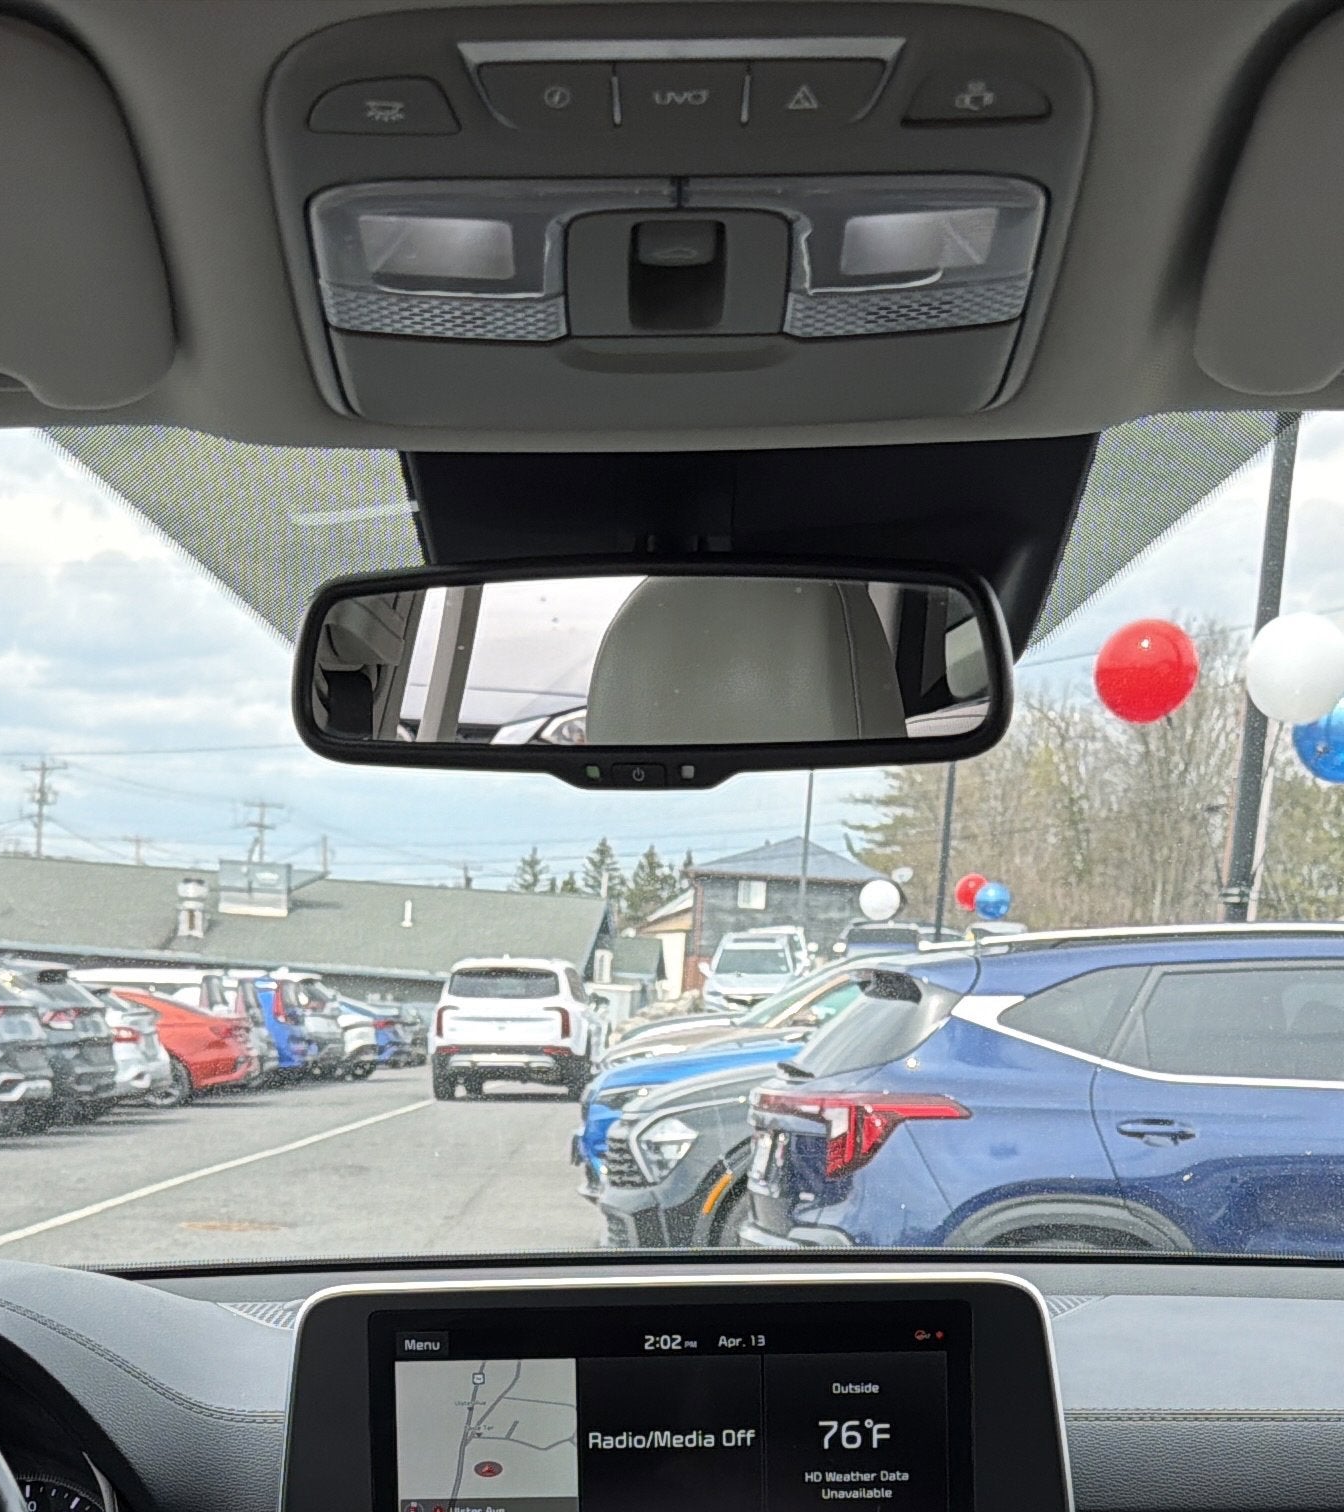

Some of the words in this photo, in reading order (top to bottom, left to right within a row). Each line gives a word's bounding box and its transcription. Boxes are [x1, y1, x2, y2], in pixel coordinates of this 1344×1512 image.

[404, 1339, 441, 1351] Menu
[644, 1335, 682, 1350] 2:02
[684, 1340, 698, 1349] PM
[718, 1335, 746, 1349] Apr.
[751, 1334, 766, 1347] 13
[831, 1382, 880, 1395] Outside
[588, 1430, 715, 1450] Radio/Media
[722, 1429, 756, 1447] Off
[818, 1418, 891, 1450] 76°F
[805, 1471, 823, 1483] HD
[825, 1470, 877, 1483] Weather
[880, 1470, 910, 1482] Data
[821, 1487, 893, 1501] Unavailable
